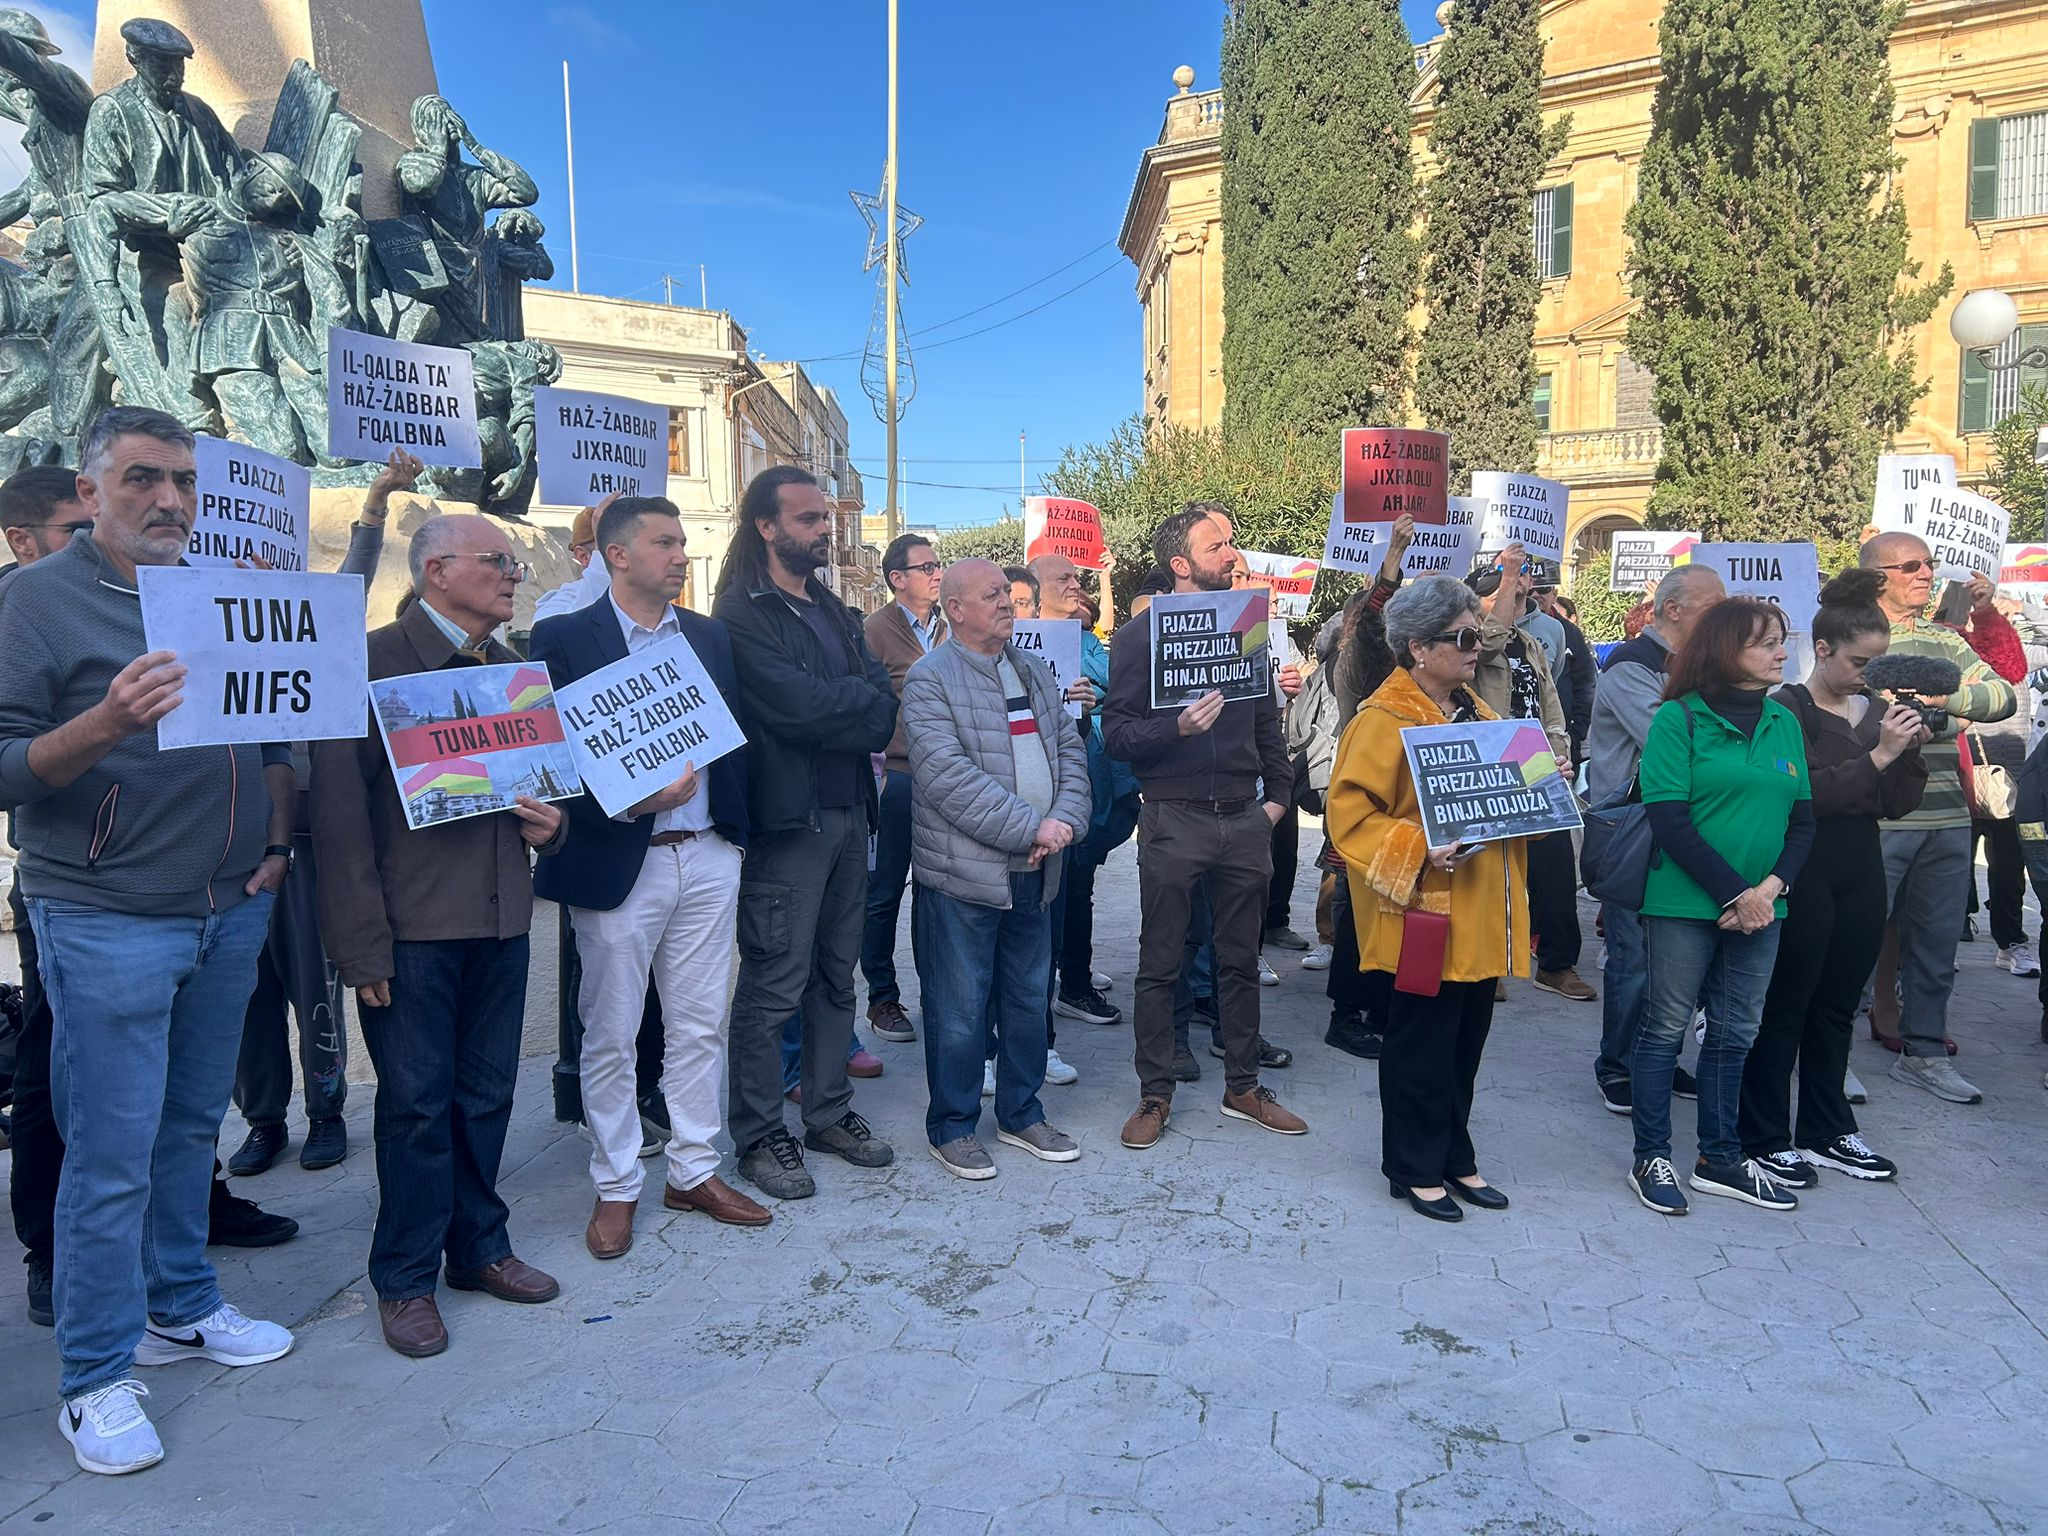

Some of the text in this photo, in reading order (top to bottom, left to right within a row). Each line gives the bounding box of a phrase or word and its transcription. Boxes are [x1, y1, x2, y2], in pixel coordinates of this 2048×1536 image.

[343, 349, 450, 387] IL-QALBA TA'
[343, 380, 460, 418] ĦAŻ-ŻABBAR
[358, 416, 447, 447] F'QALBNA
[559, 404, 657, 440] ĦAŻ-ŻABBAR
[572, 440, 646, 468] JIXRAQLU
[1361, 439, 1441, 462] ĦAŻ-ŻABBAR
[229, 459, 286, 497] PJAZZA
[589, 473, 640, 497] AĦJAR!
[1370, 469, 1432, 487] JIXRAQLU
[1383, 495, 1426, 512] AĦJAR!
[1507, 483, 1547, 503] PJAZZA
[202, 493, 297, 539] PREZZJUŻA,
[1047, 505, 1096, 525] AŻ-ŻABBA
[1491, 504, 1555, 529] PREZZJUŻA,
[1930, 497, 1988, 532] IL-QALBA
[189, 530, 256, 561] BINJA
[1045, 526, 1093, 542] JIXRAQLU
[1524, 528, 1560, 551] ODJUŻA
[1619, 542, 1652, 553] PJAZZA
[1925, 519, 2001, 561] ĦAŻ-ŻABBAR
[1332, 546, 1369, 564] BINJA
[1407, 555, 1451, 570] AĦJAR!
[1934, 544, 1992, 578] F'QALBNA
[1617, 570, 1646, 581] BINJA
[1727, 558, 1783, 581] TUNA
[2002, 569, 2031, 581] NIFS
[1277, 580, 1300, 592] NIFS
[214, 597, 318, 643] TUNA
[1162, 612, 1213, 633] PJAZZA
[1163, 634, 1239, 661] PREZZJUŻA,
[1163, 667, 1208, 687] BINJA
[1211, 659, 1251, 684] ODJUŻA
[222, 669, 312, 715] NIFS
[564, 657, 681, 732] IL-QALBA TA'
[584, 684, 707, 759] ĦAŻ-ŻABBAR
[429, 717, 539, 755] TUNA NIFS
[620, 720, 709, 779] F'QALBNA
[1418, 743, 1476, 767] PJAZZA
[1426, 764, 1520, 795] PREZZJUŻA,
[1434, 789, 1549, 825] BINJA ODJUŻA
